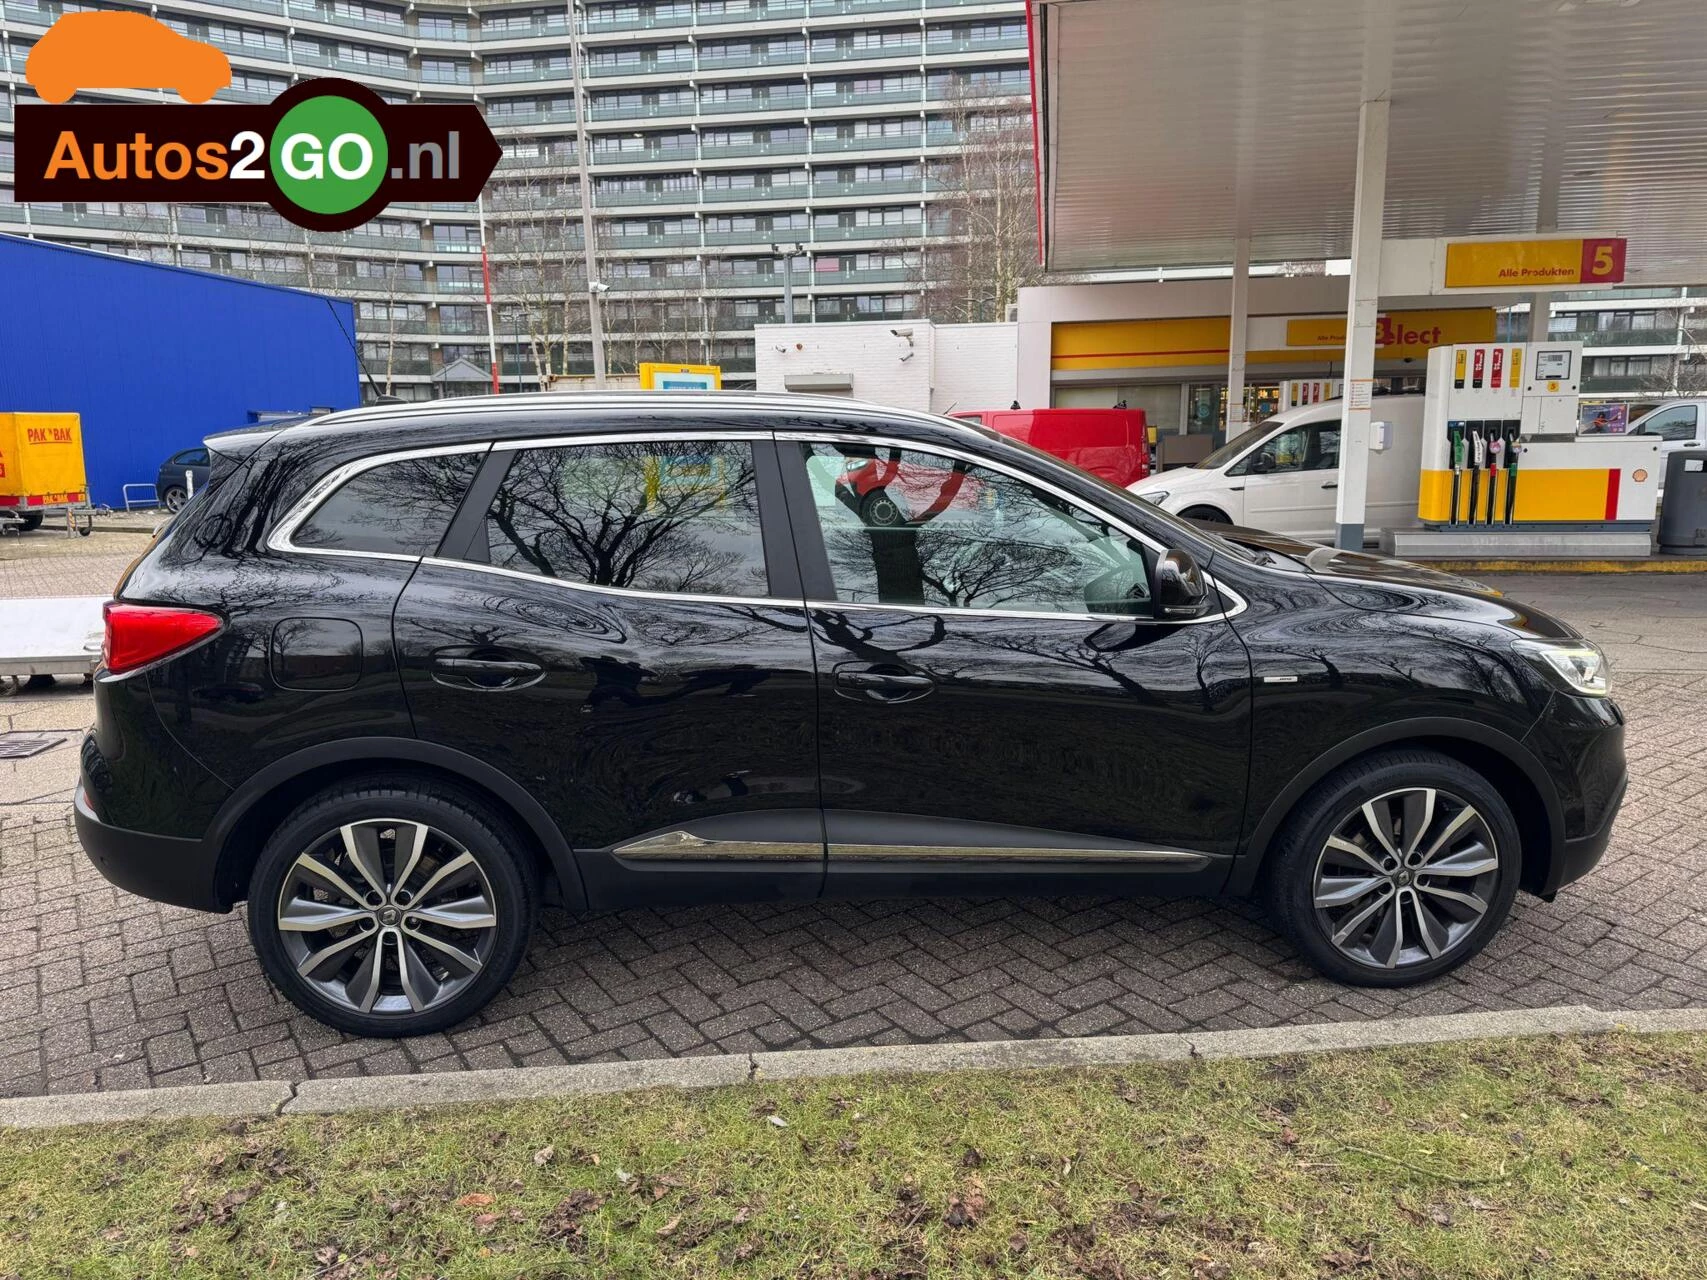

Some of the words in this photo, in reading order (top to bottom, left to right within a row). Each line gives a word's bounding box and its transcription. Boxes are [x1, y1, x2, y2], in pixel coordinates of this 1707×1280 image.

[1591, 245, 1614, 276] 5
[1498, 268, 1519, 278] Alle
[1521, 267, 1575, 277] Produkten
[27, 428, 47, 442] PAK
[53, 427, 73, 441] BAK
